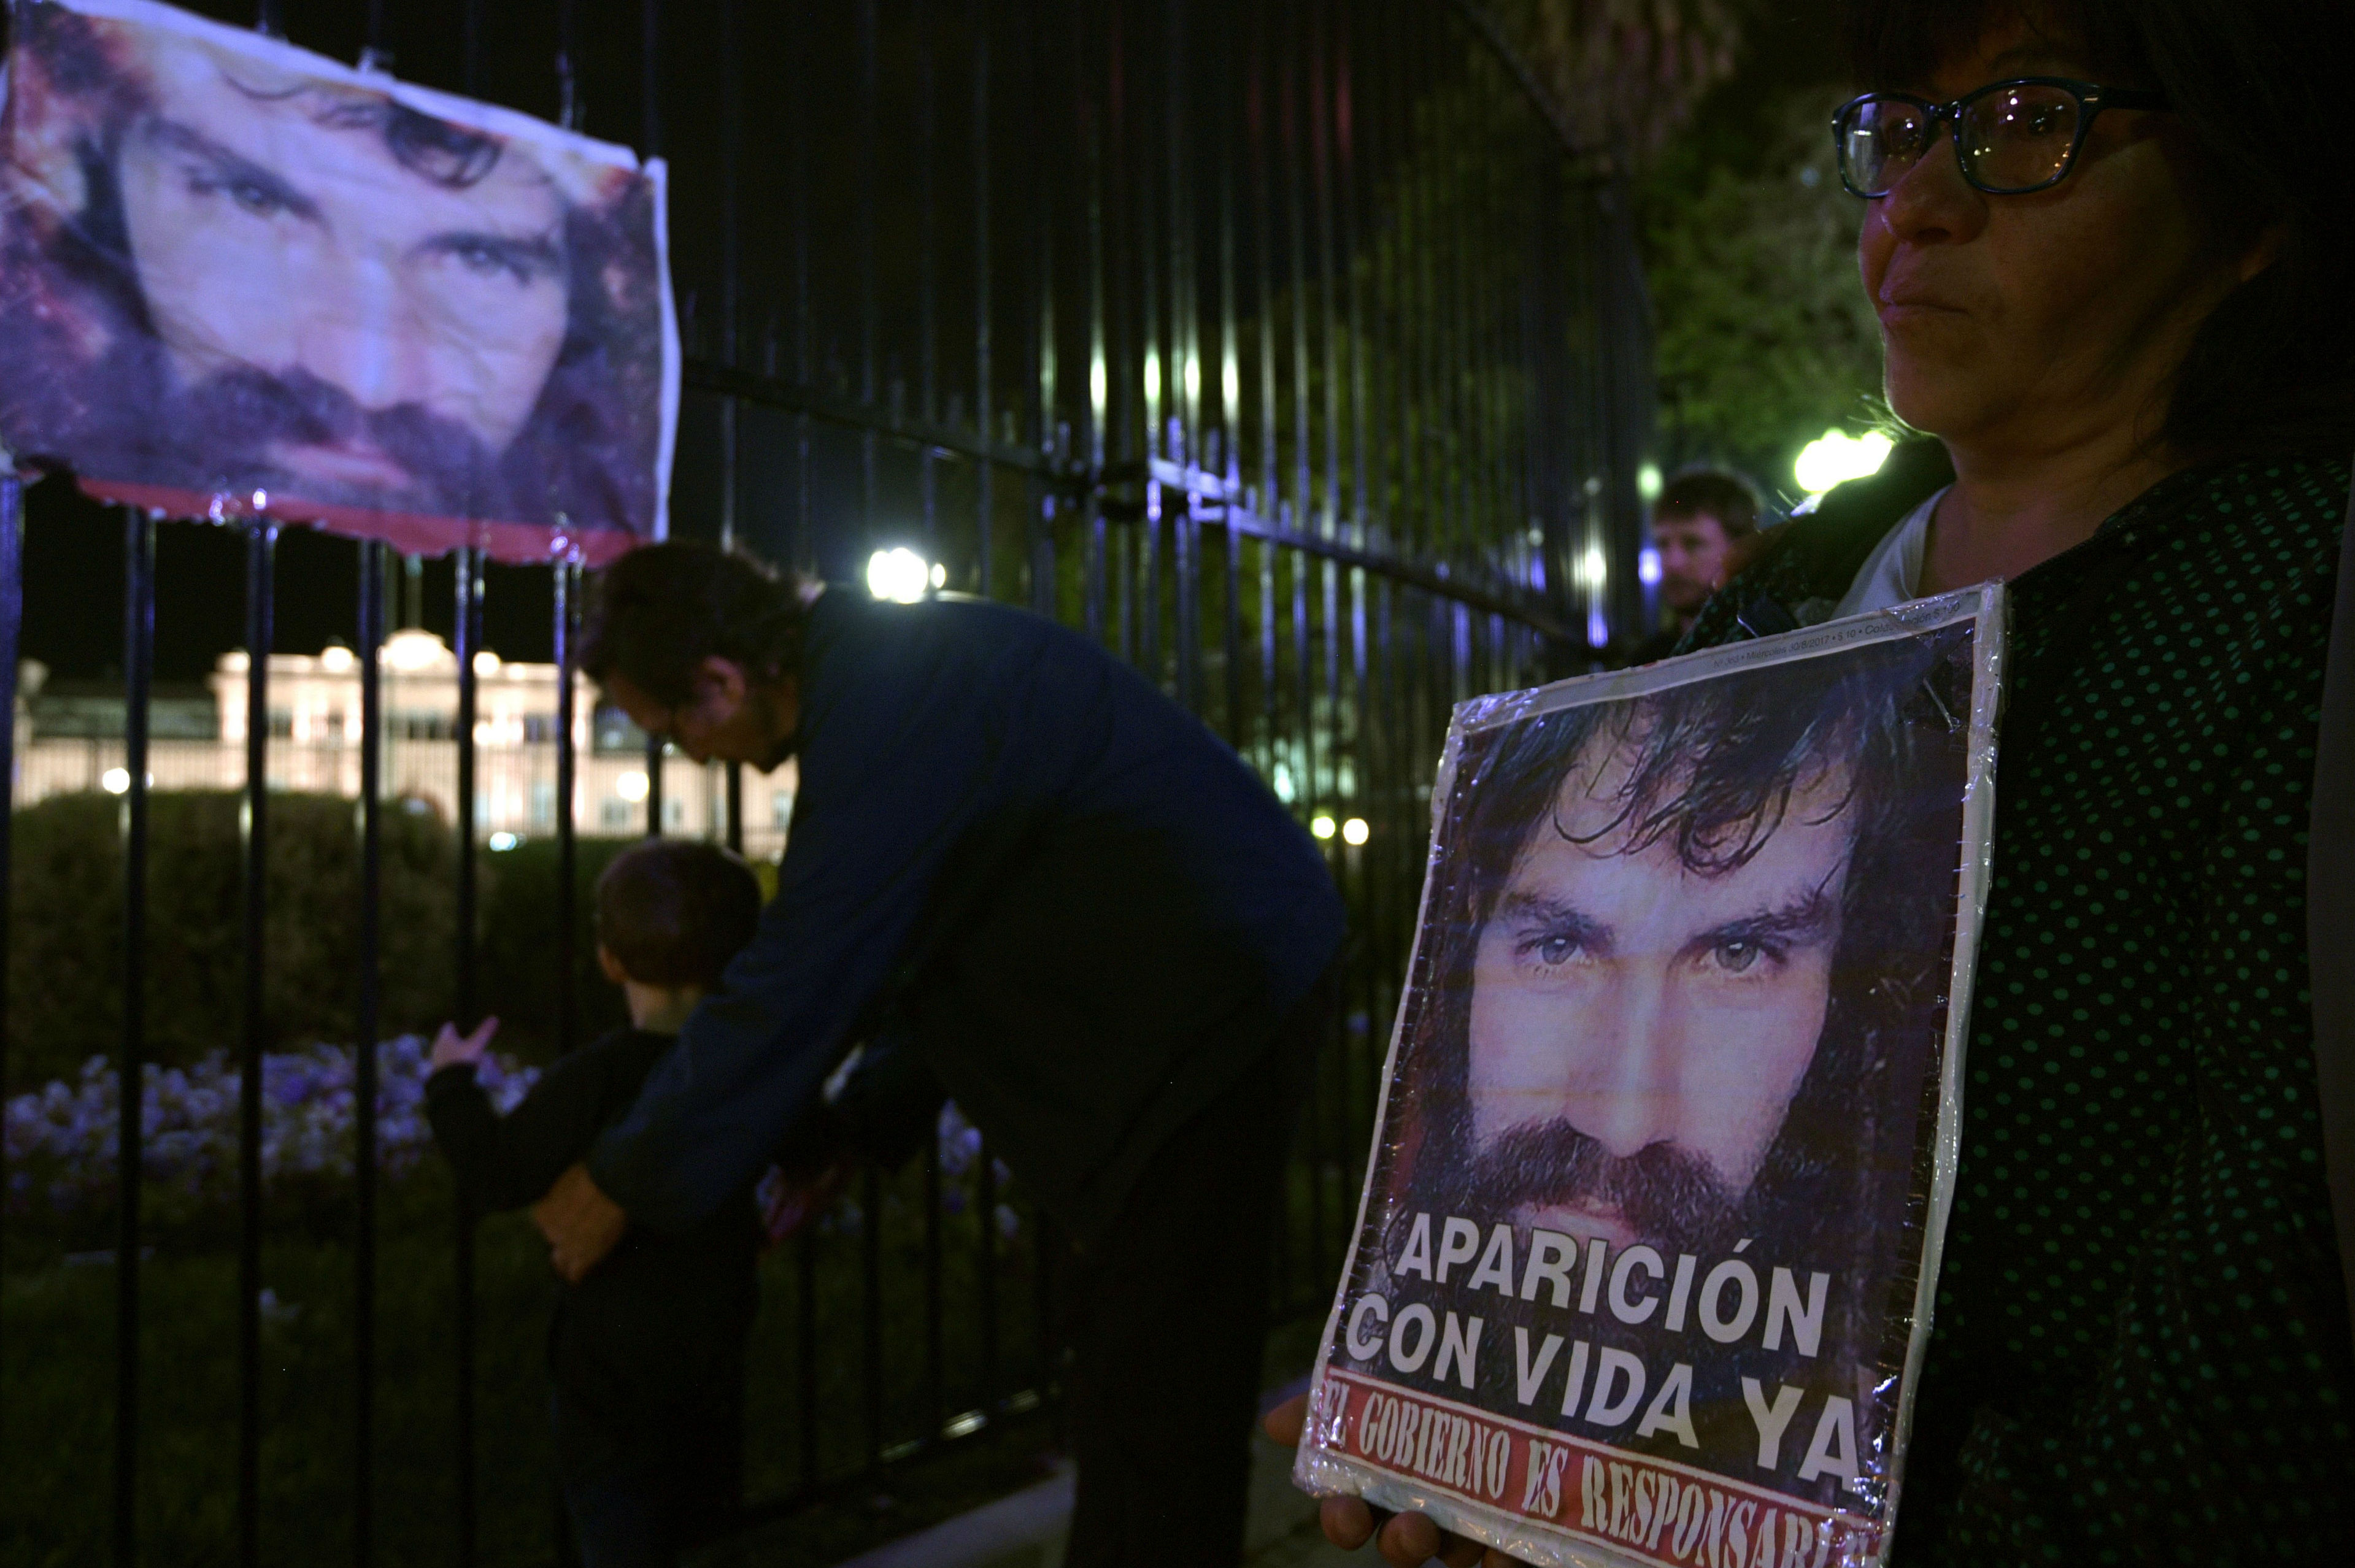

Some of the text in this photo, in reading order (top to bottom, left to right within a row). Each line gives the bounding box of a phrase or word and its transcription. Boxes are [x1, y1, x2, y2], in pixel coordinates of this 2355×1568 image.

[1394, 1212, 1830, 1357] APARICIÓN
[1346, 1293, 1864, 1496] CON VIDA YA
[1359, 1391, 1510, 1499] GOBIERNO
[1521, 1439, 1568, 1518] ES
